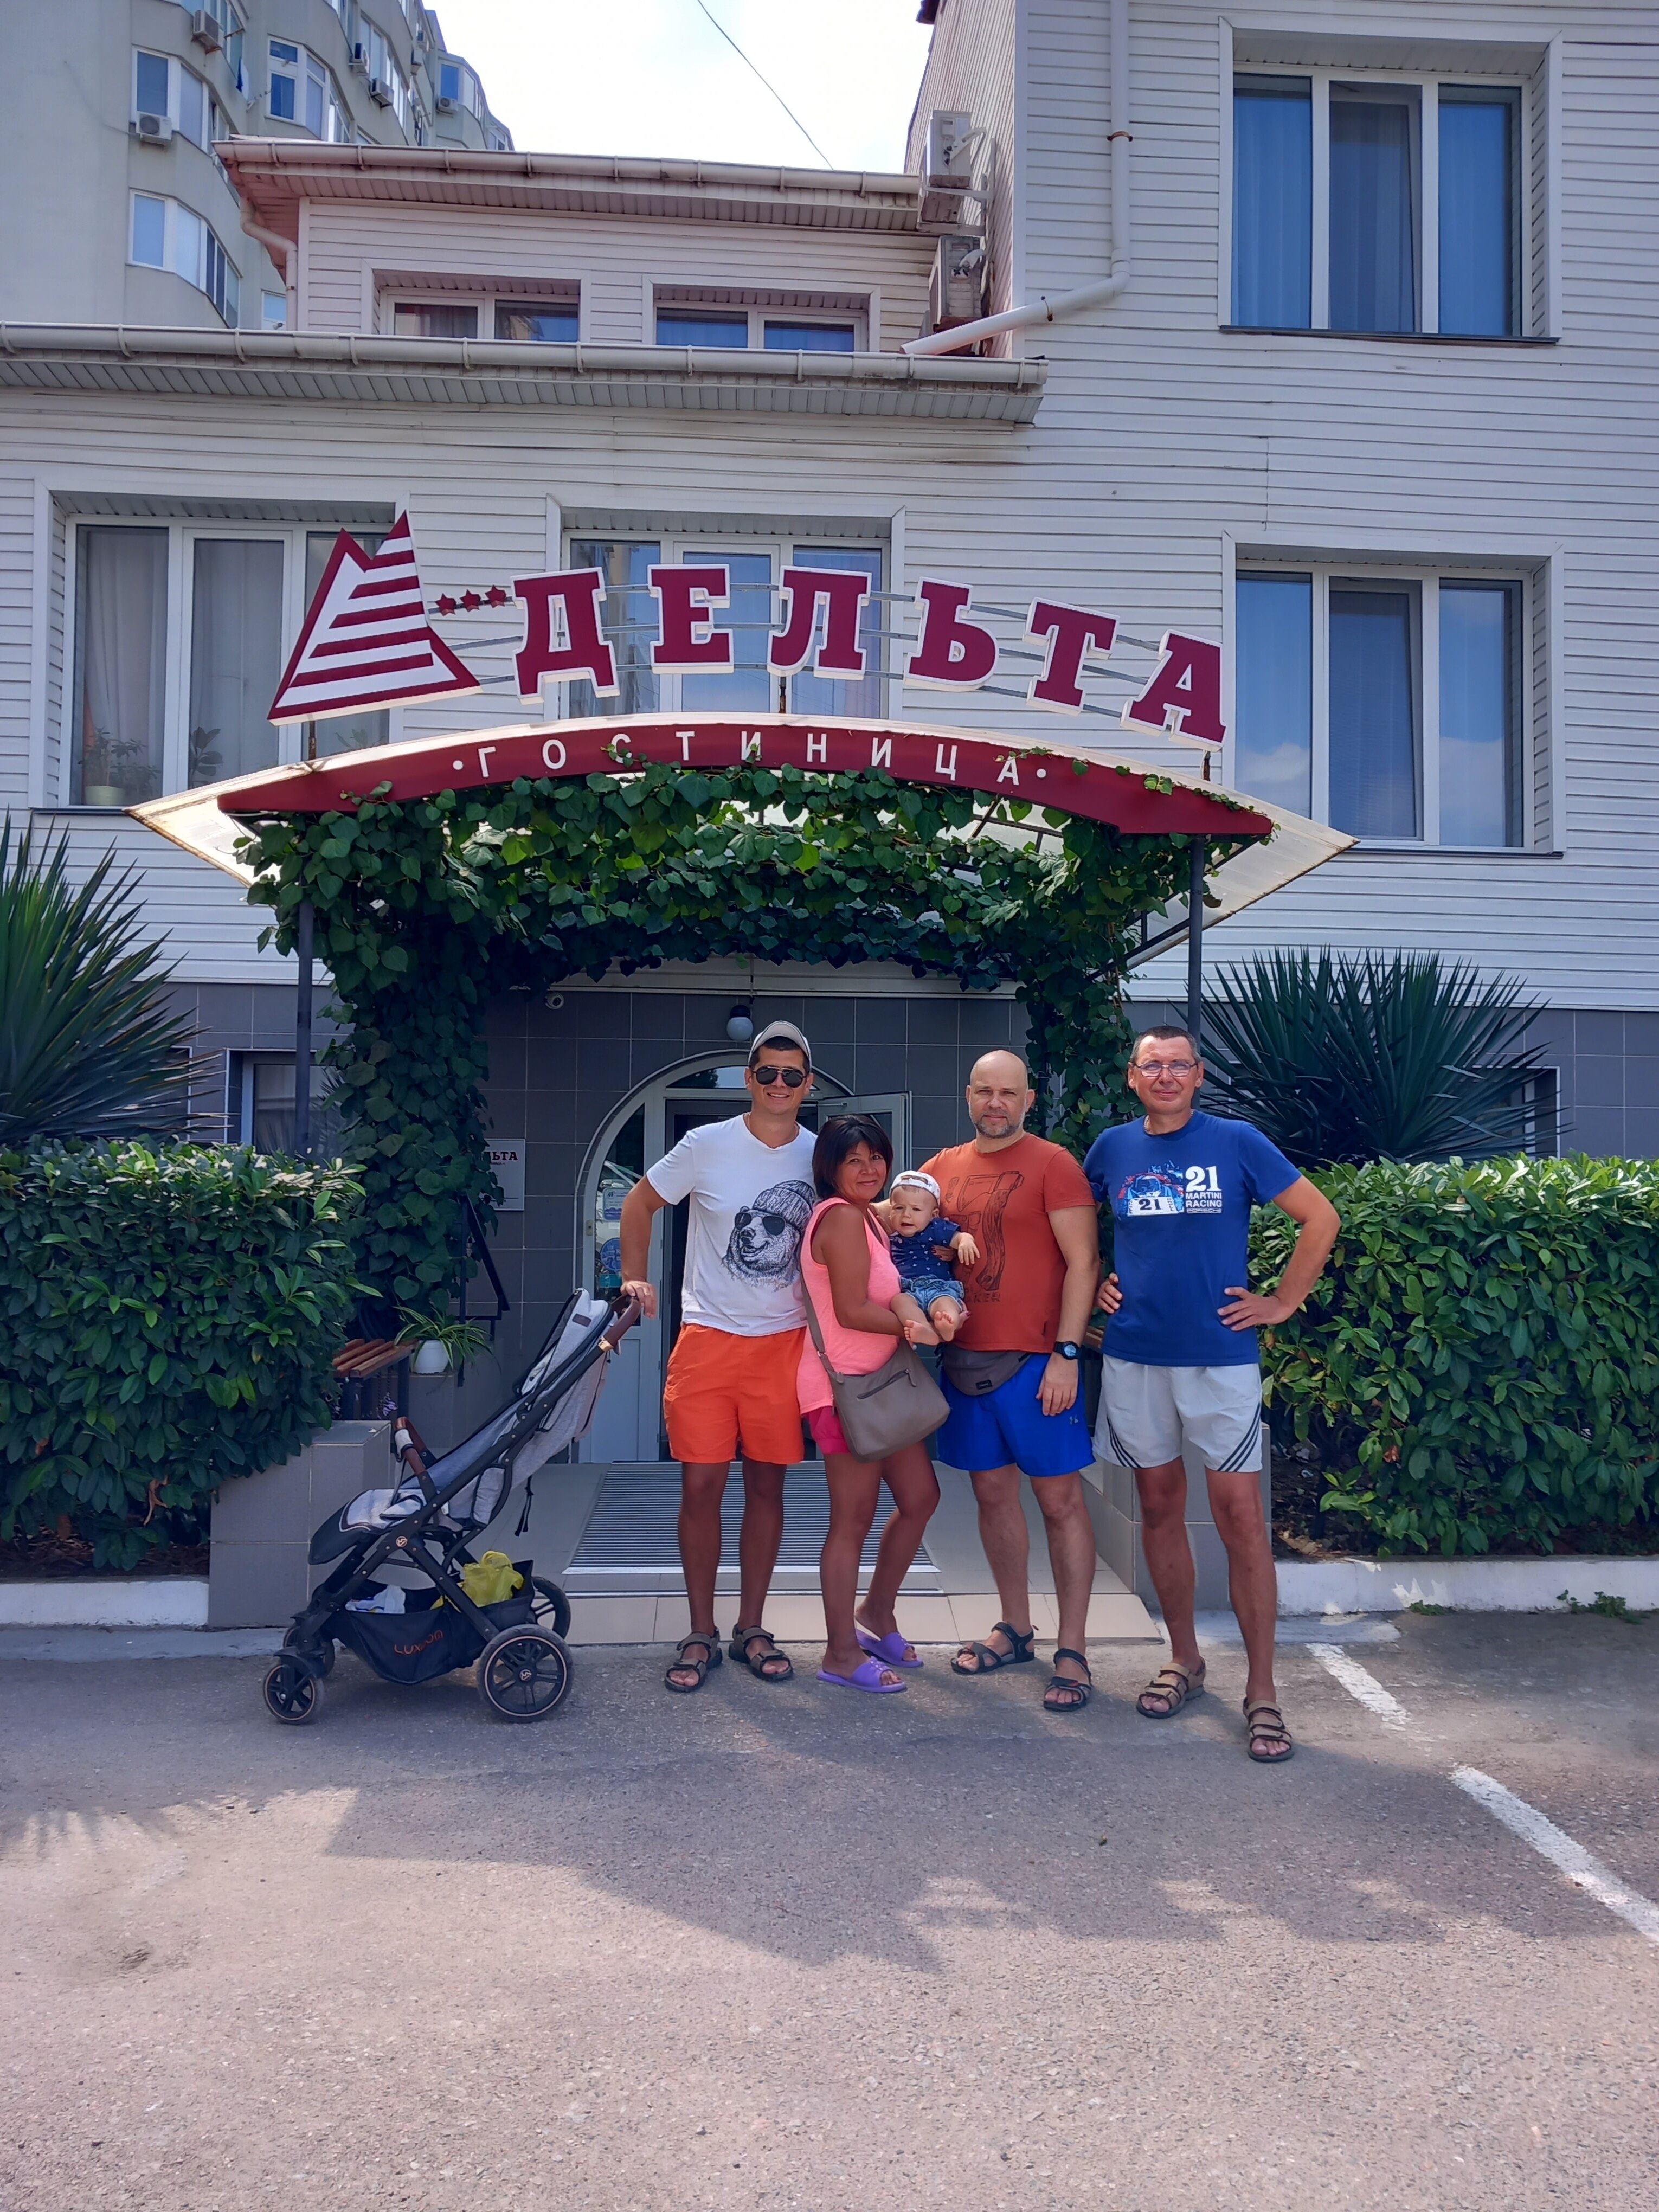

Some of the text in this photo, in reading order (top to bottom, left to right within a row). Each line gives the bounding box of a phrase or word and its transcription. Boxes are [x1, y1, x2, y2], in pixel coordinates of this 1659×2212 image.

[512, 563, 1229, 753] ДЕЛЬТА
[478, 730, 1020, 786] ГОСТИНИЦА
[1185, 1166, 1222, 1192] 21
[1138, 1198, 1163, 1210] 21
